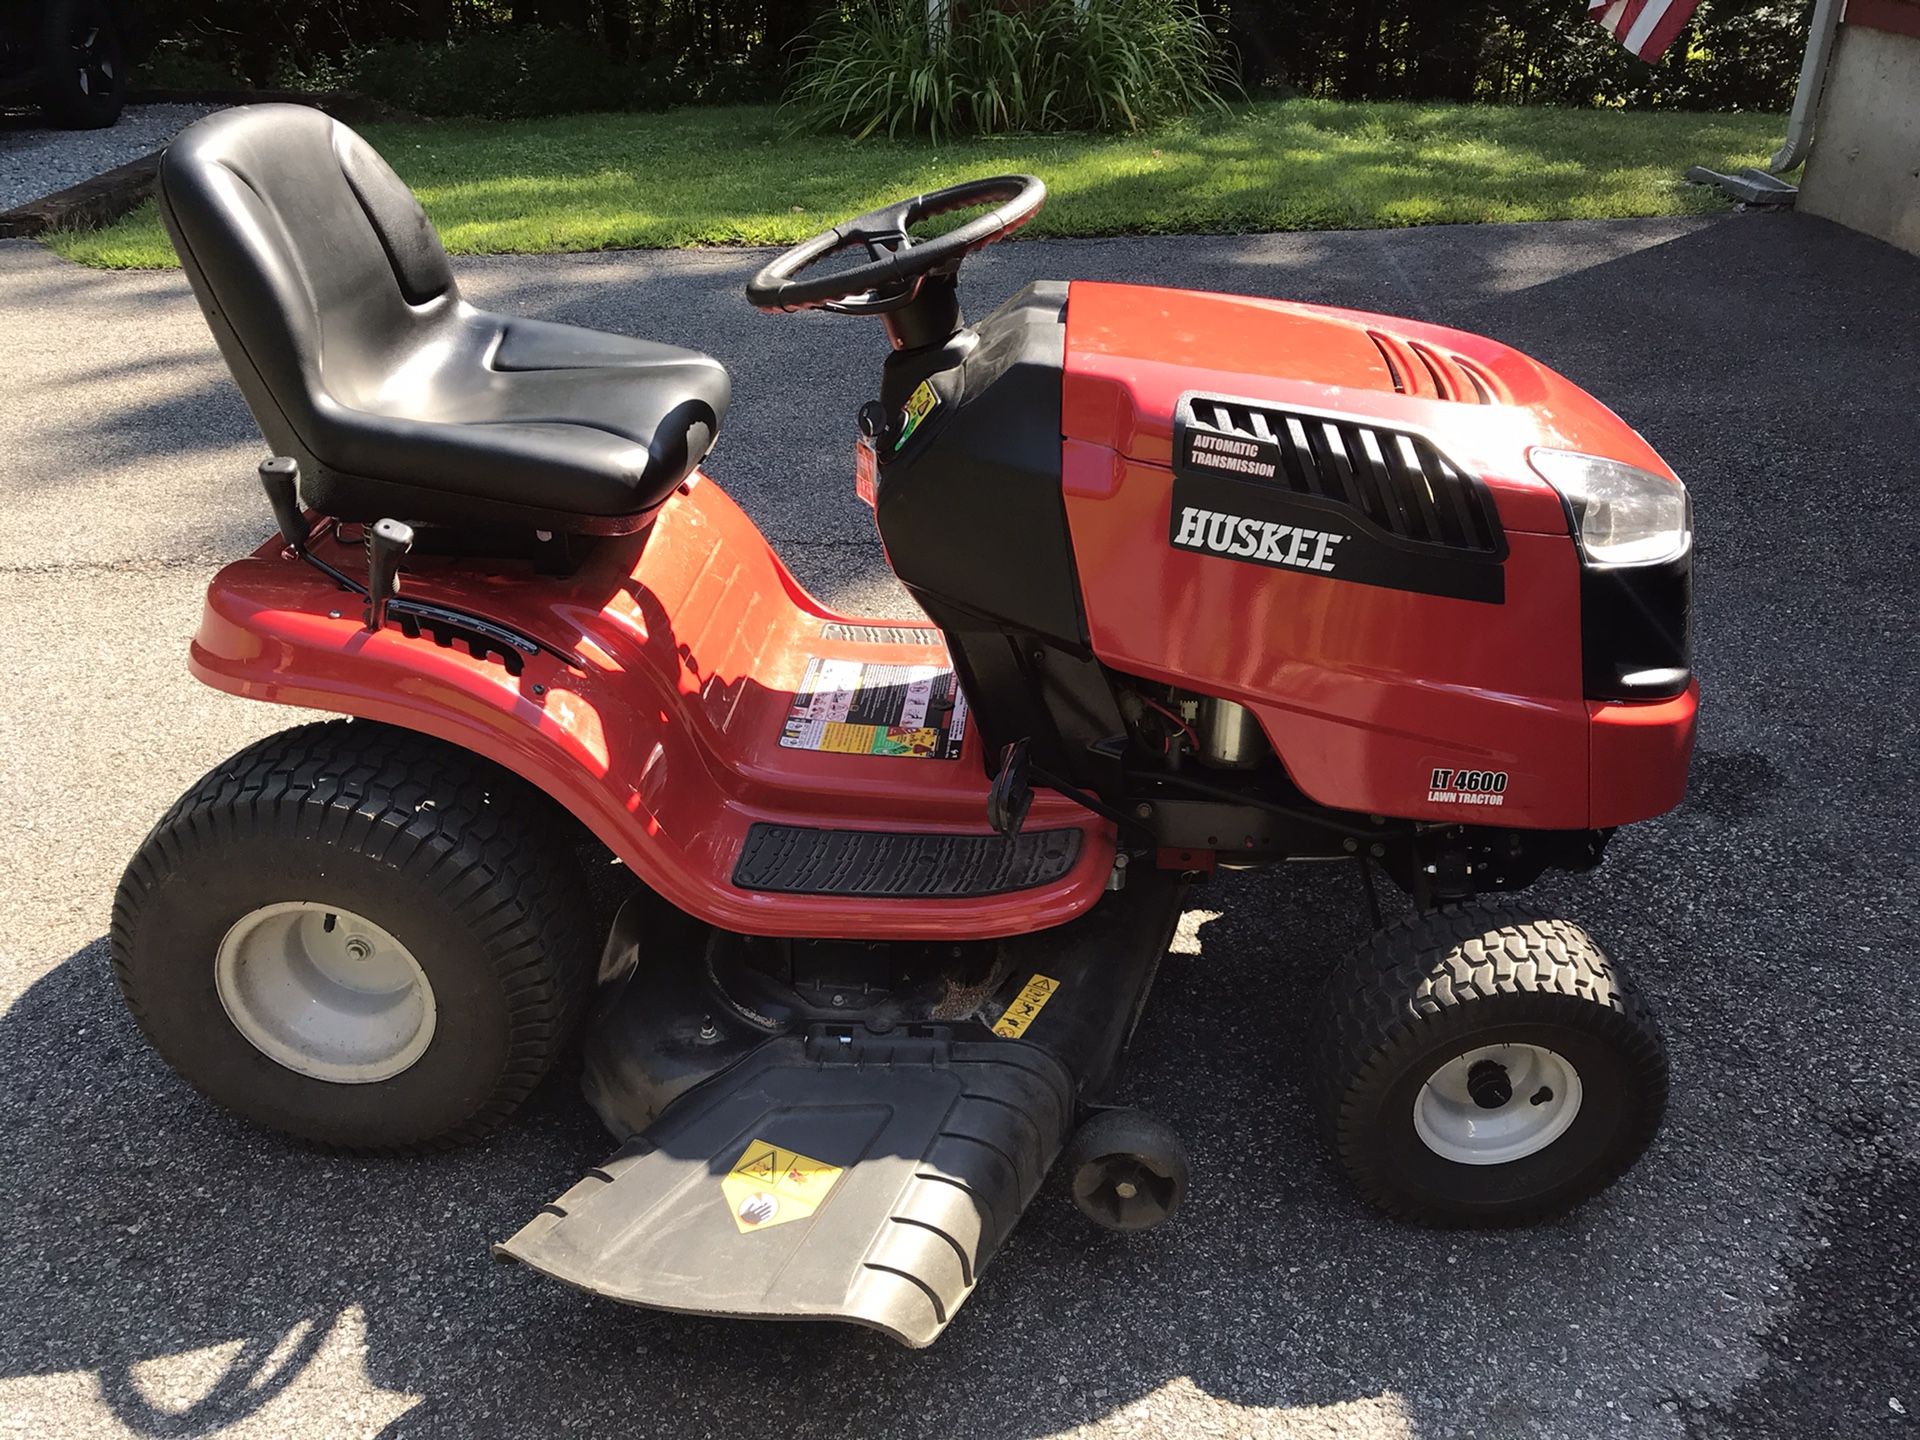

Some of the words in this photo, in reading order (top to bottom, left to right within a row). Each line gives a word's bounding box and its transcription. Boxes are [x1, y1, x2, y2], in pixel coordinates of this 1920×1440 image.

[1193, 434, 1259, 458] AUTOMATIC
[1191, 450, 1276, 478] TRANSMISSION
[1173, 506, 1344, 572] HUSKEE
[1430, 768, 1454, 790] LT
[1453, 769, 1509, 793] 4600
[1427, 791, 1457, 803] LAWN
[1458, 792, 1504, 806] TRACTOR
